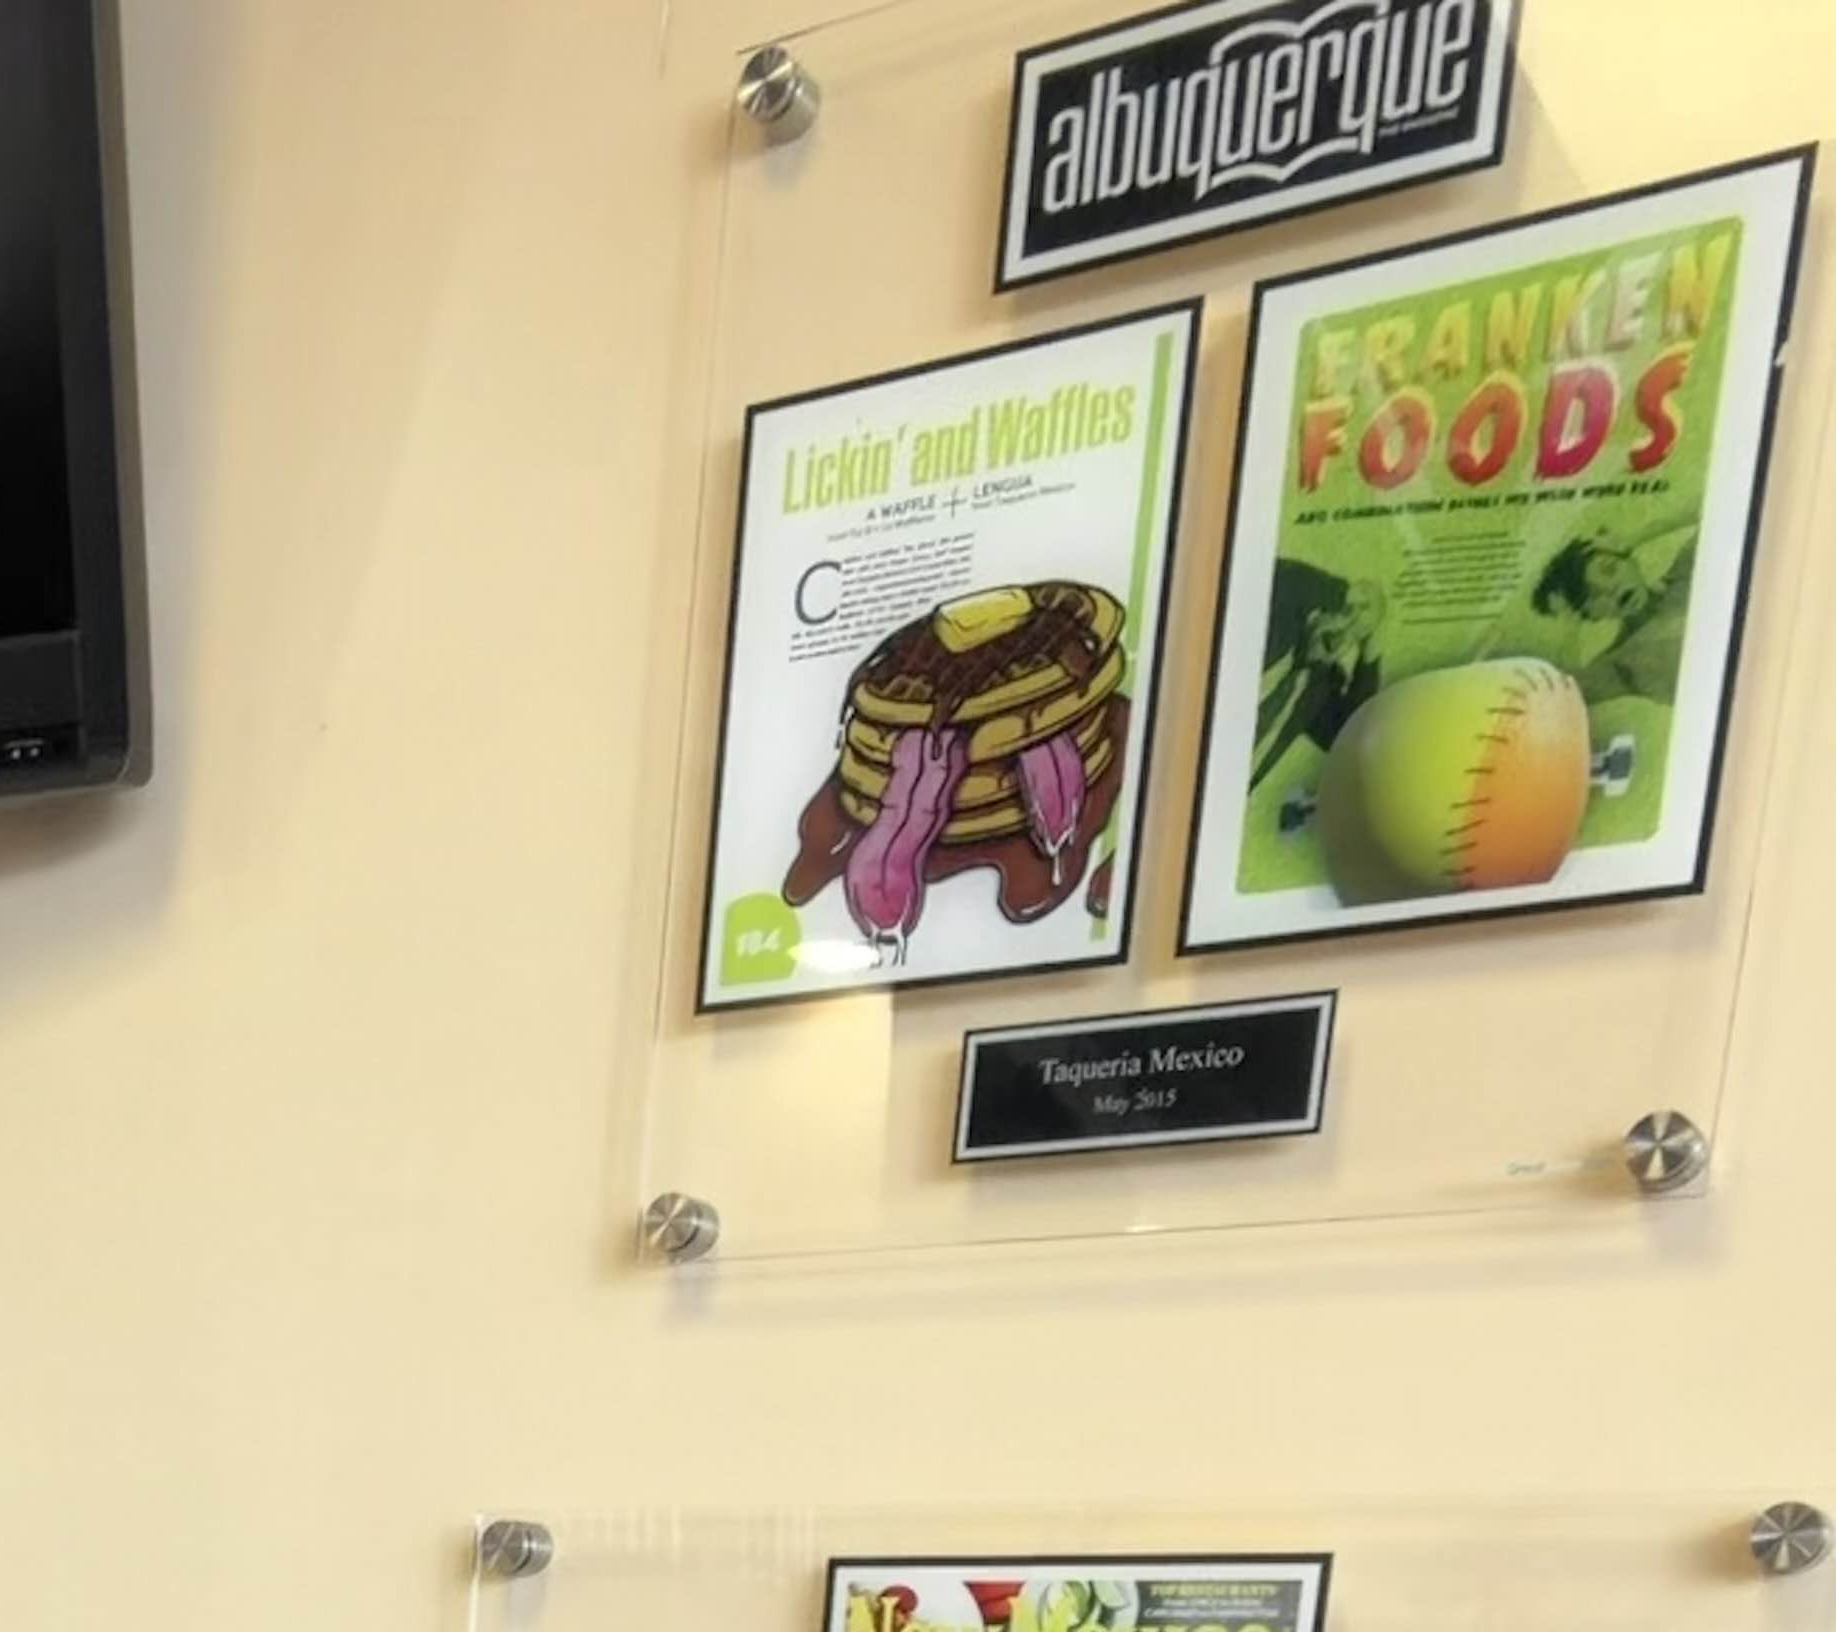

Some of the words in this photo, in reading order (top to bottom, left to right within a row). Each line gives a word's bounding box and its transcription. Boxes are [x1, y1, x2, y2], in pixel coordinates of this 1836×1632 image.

[1042, 0, 1474, 212] albuquerque
[1311, 233, 1733, 398] FRANKEN
[910, 405, 980, 487] and
[986, 382, 1136, 470] Waffles
[1299, 340, 1697, 492] FOODS
[1039, 1050, 1141, 1087] Taqueria
[1149, 1041, 1244, 1073] Mexico
[1094, 1095, 1130, 1116] May
[1134, 1088, 1176, 1111] 2015
